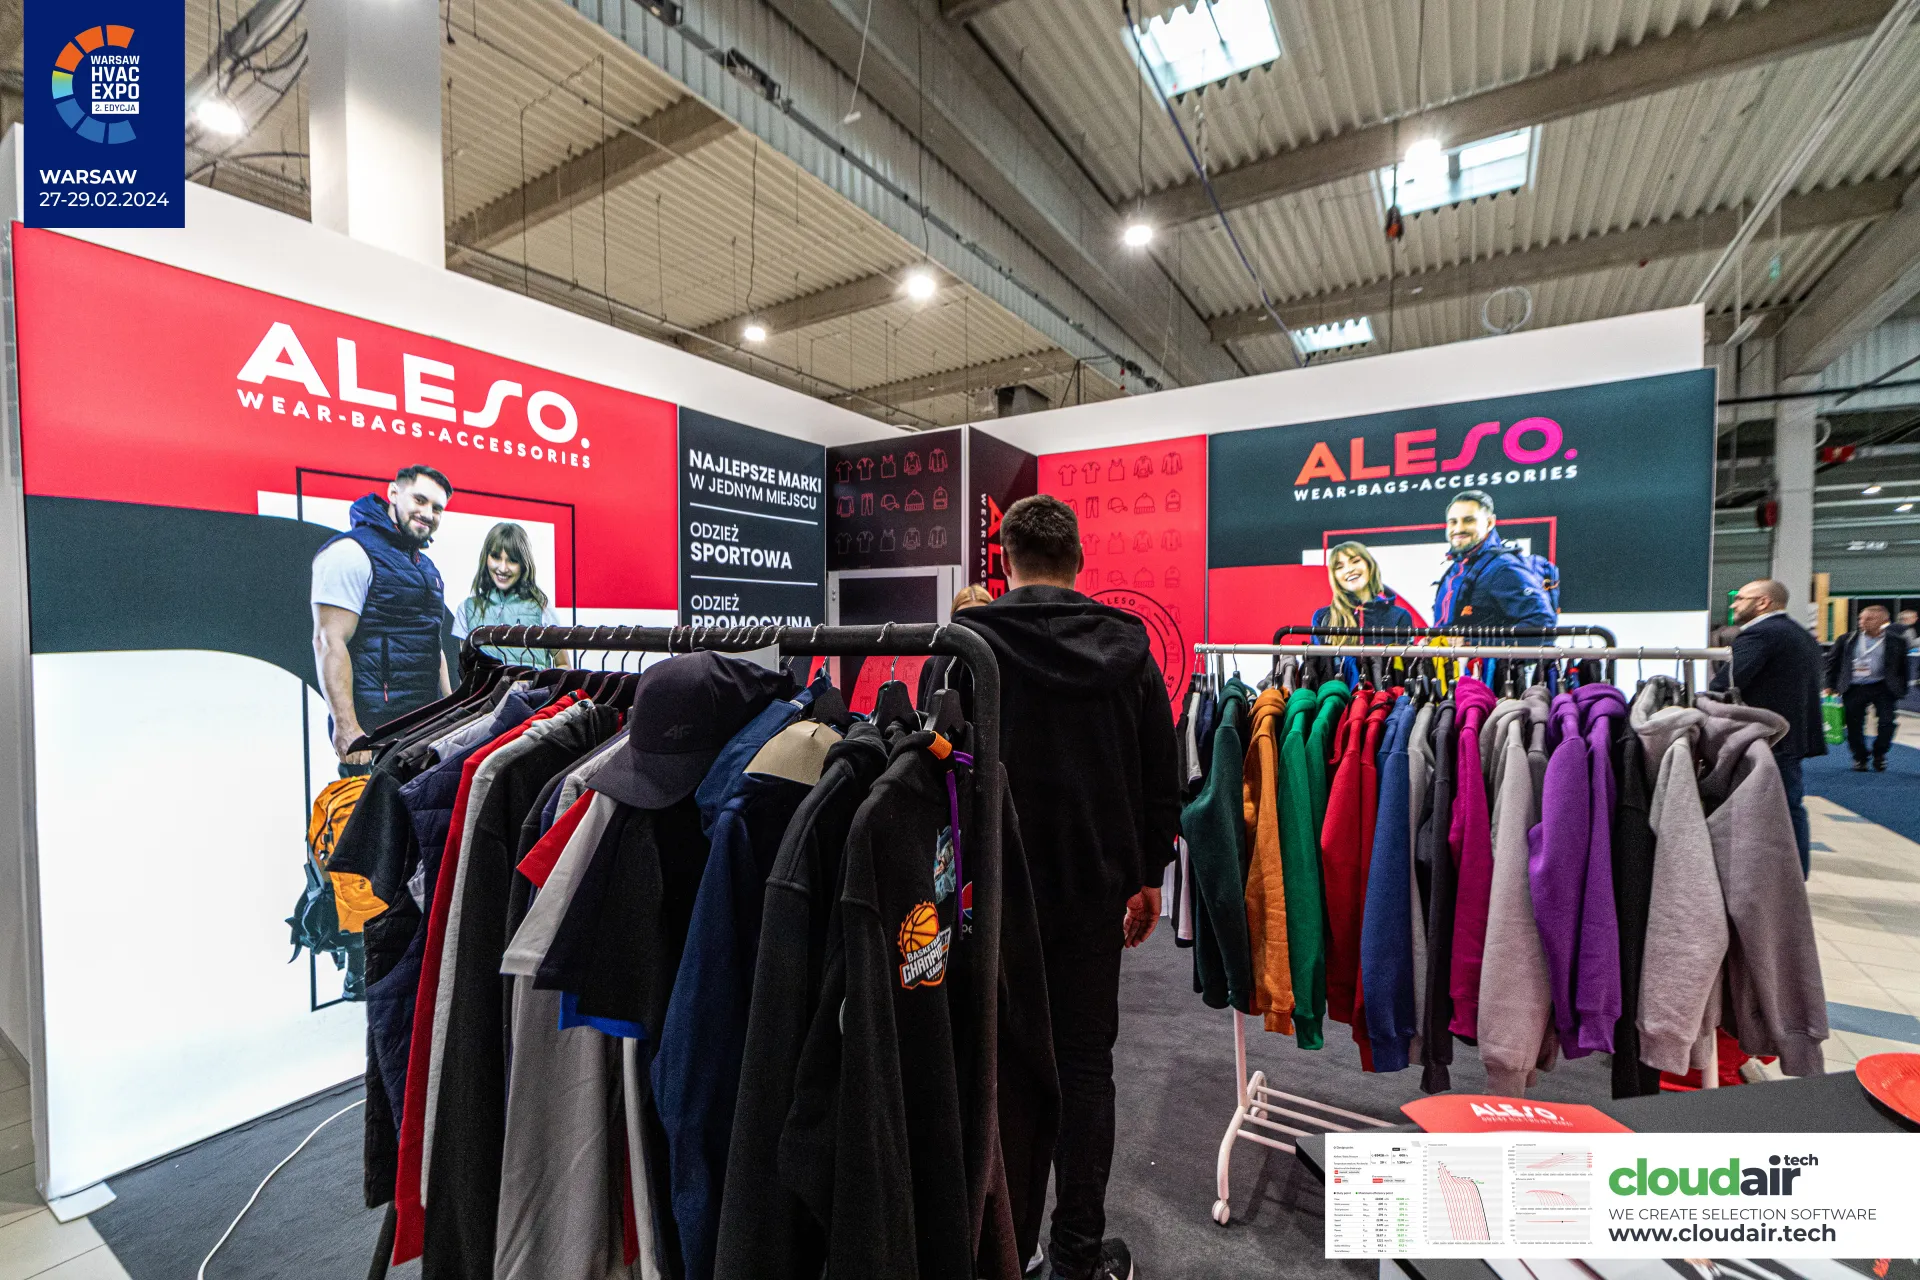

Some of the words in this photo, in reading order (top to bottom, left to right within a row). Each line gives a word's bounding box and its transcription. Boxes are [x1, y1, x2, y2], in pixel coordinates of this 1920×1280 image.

[236, 388, 591, 469] WEAR-BAGS-ACCESSORIES
[689, 449, 776, 485] NAJLEPSZE
[778, 470, 822, 493] MARKI
[1294, 465, 1578, 501] WEAR-BAGS-ACCESSORIES
[689, 472, 705, 490] W
[708, 478, 763, 501] JEDNYM
[766, 488, 817, 510] MIEJSCU
[690, 521, 739, 542] ODZIEŻ
[690, 541, 792, 569] SPORTOWA
[691, 593, 739, 611] ODZIEŻ
